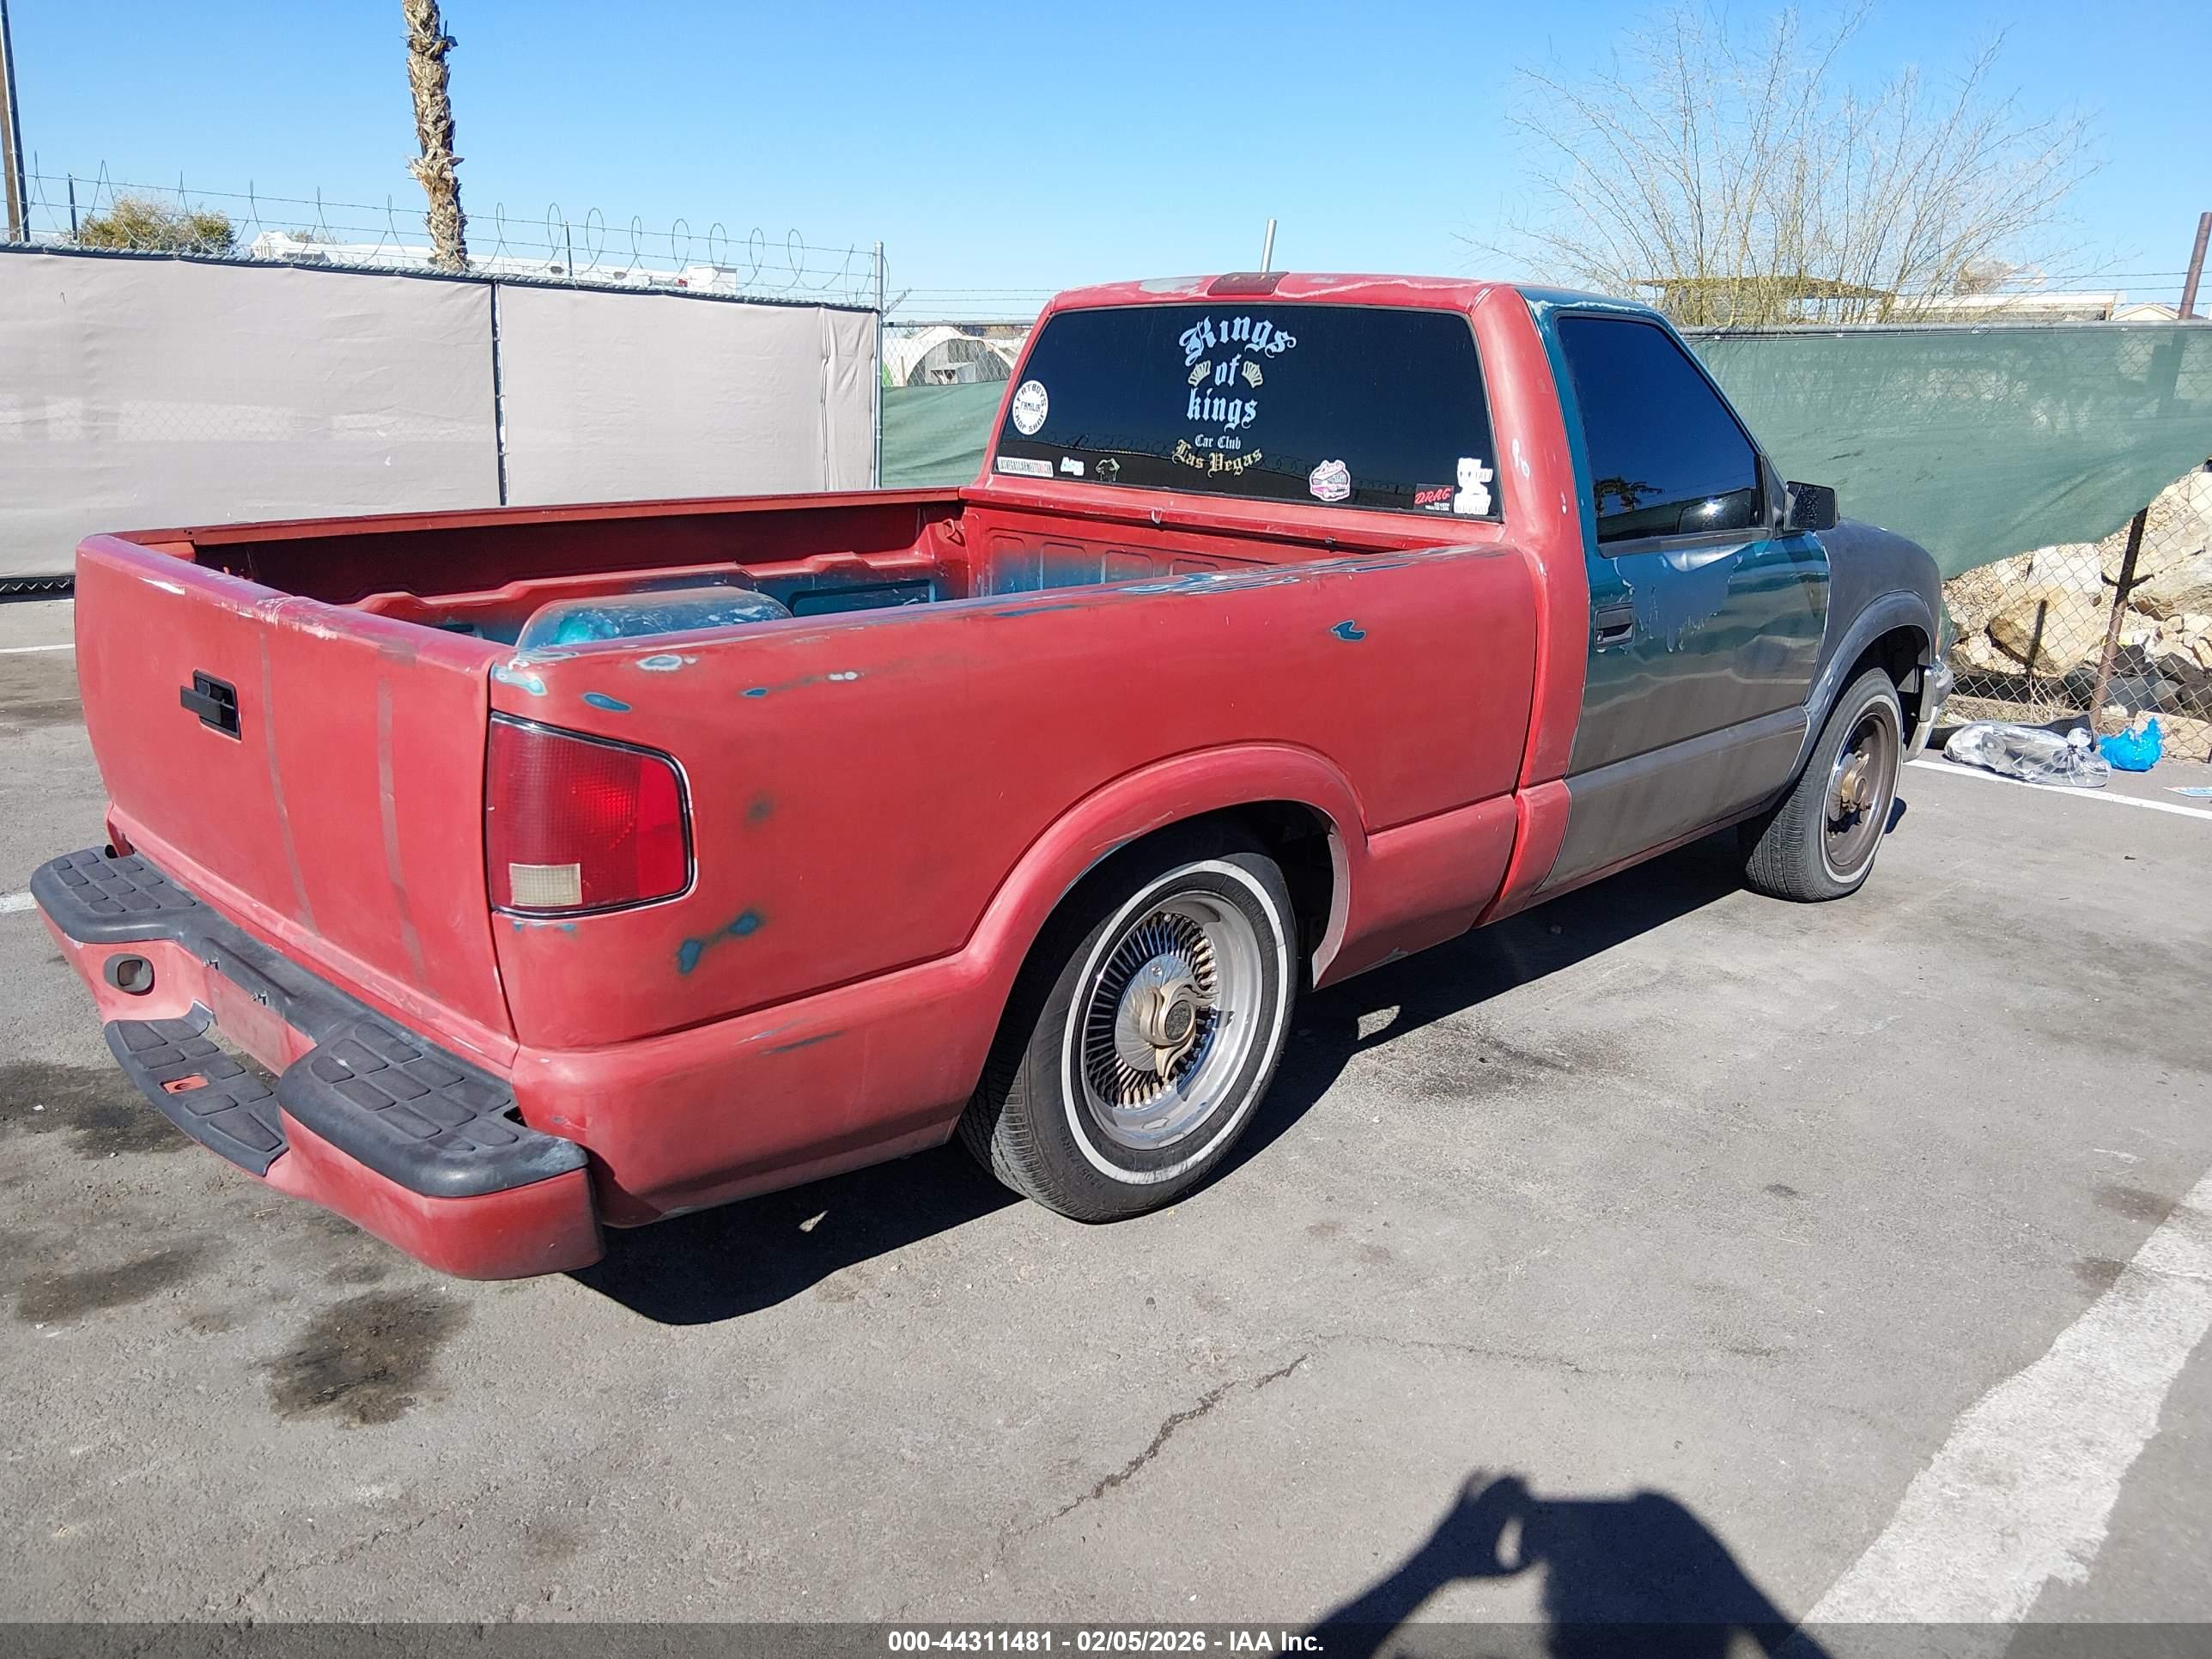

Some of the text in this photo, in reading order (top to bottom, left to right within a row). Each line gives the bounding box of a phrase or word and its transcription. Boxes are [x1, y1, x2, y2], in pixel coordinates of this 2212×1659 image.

[1179, 315, 1297, 367] Kings
[1214, 354, 1243, 386] of
[1187, 387, 1258, 433] kings
[1172, 439, 1263, 478] Las Vegas
[1195, 434, 1242, 450] Car Club
